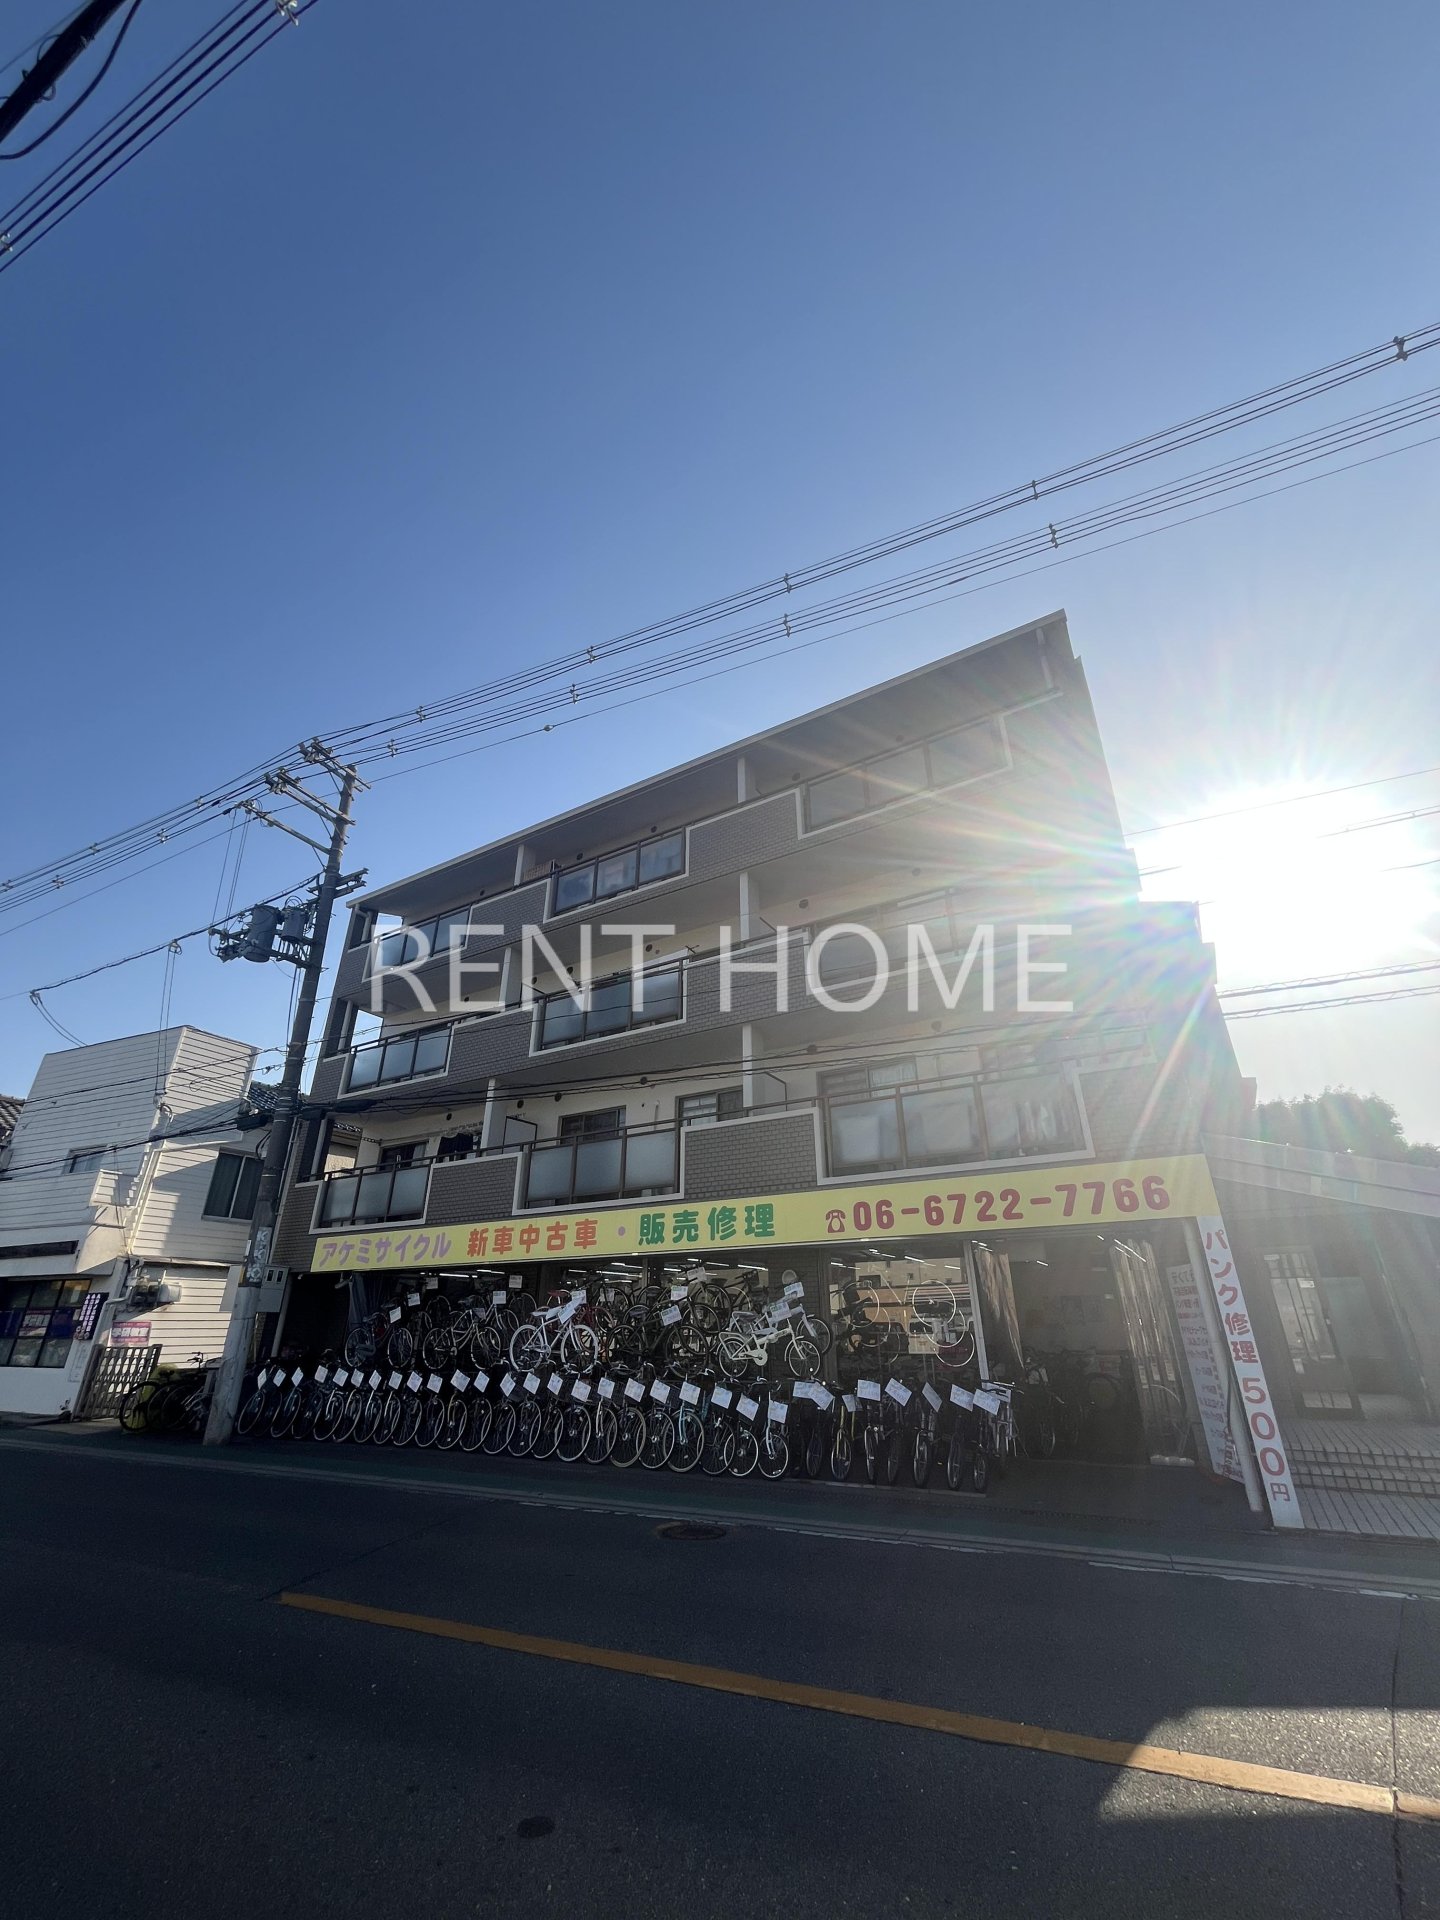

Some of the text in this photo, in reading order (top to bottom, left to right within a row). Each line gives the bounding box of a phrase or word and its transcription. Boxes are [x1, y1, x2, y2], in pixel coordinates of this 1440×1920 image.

[319, 1231, 452, 1267] アケミサイクル
[853, 1175, 1170, 1232] 06-6722-7766
